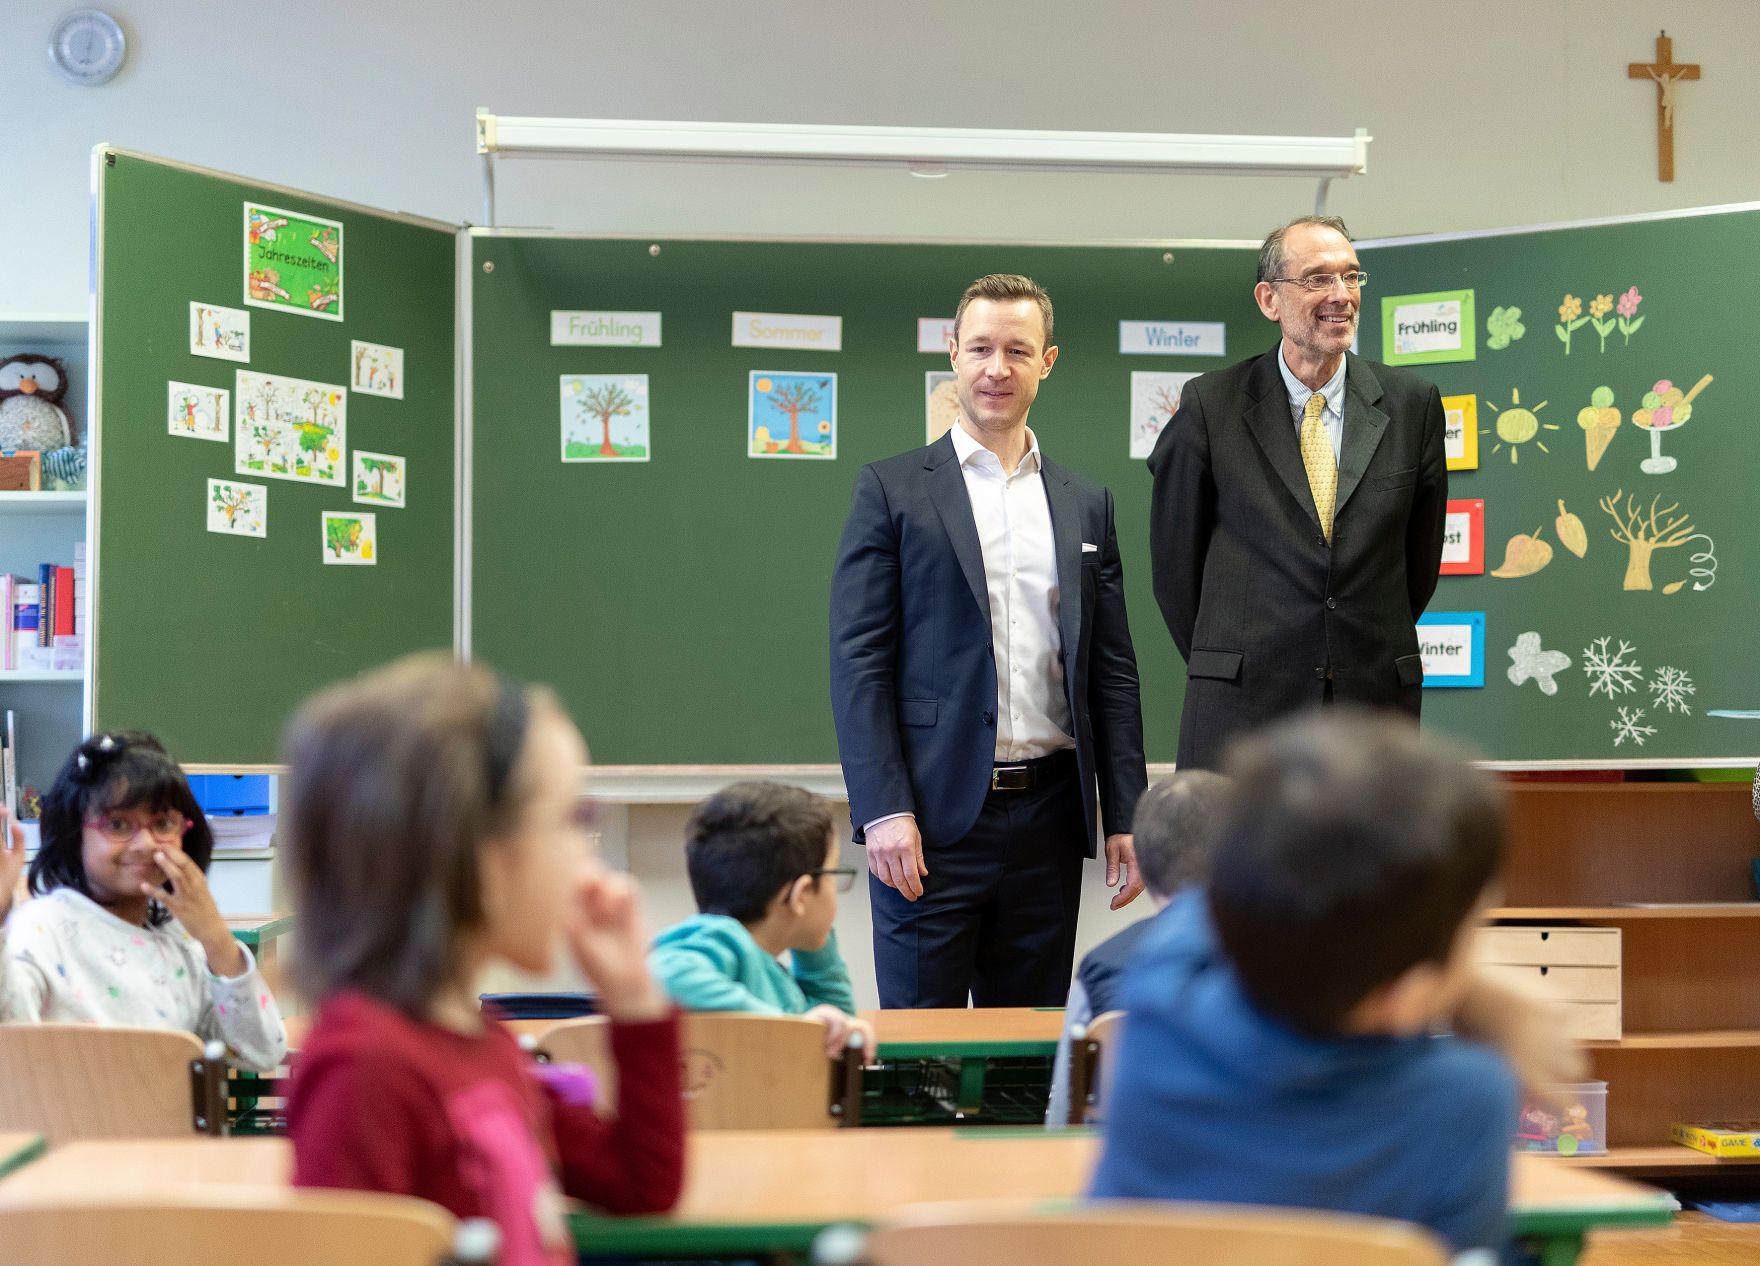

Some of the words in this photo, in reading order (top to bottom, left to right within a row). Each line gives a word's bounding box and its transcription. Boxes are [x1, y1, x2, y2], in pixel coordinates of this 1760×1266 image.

[258, 245, 330, 272] Jahreszeiten
[569, 315, 644, 345] Frühling
[749, 318, 824, 342] Sommer
[1145, 326, 1201, 348] Winter
[1398, 319, 1457, 336] Frühling
[1445, 427, 1462, 439] er
